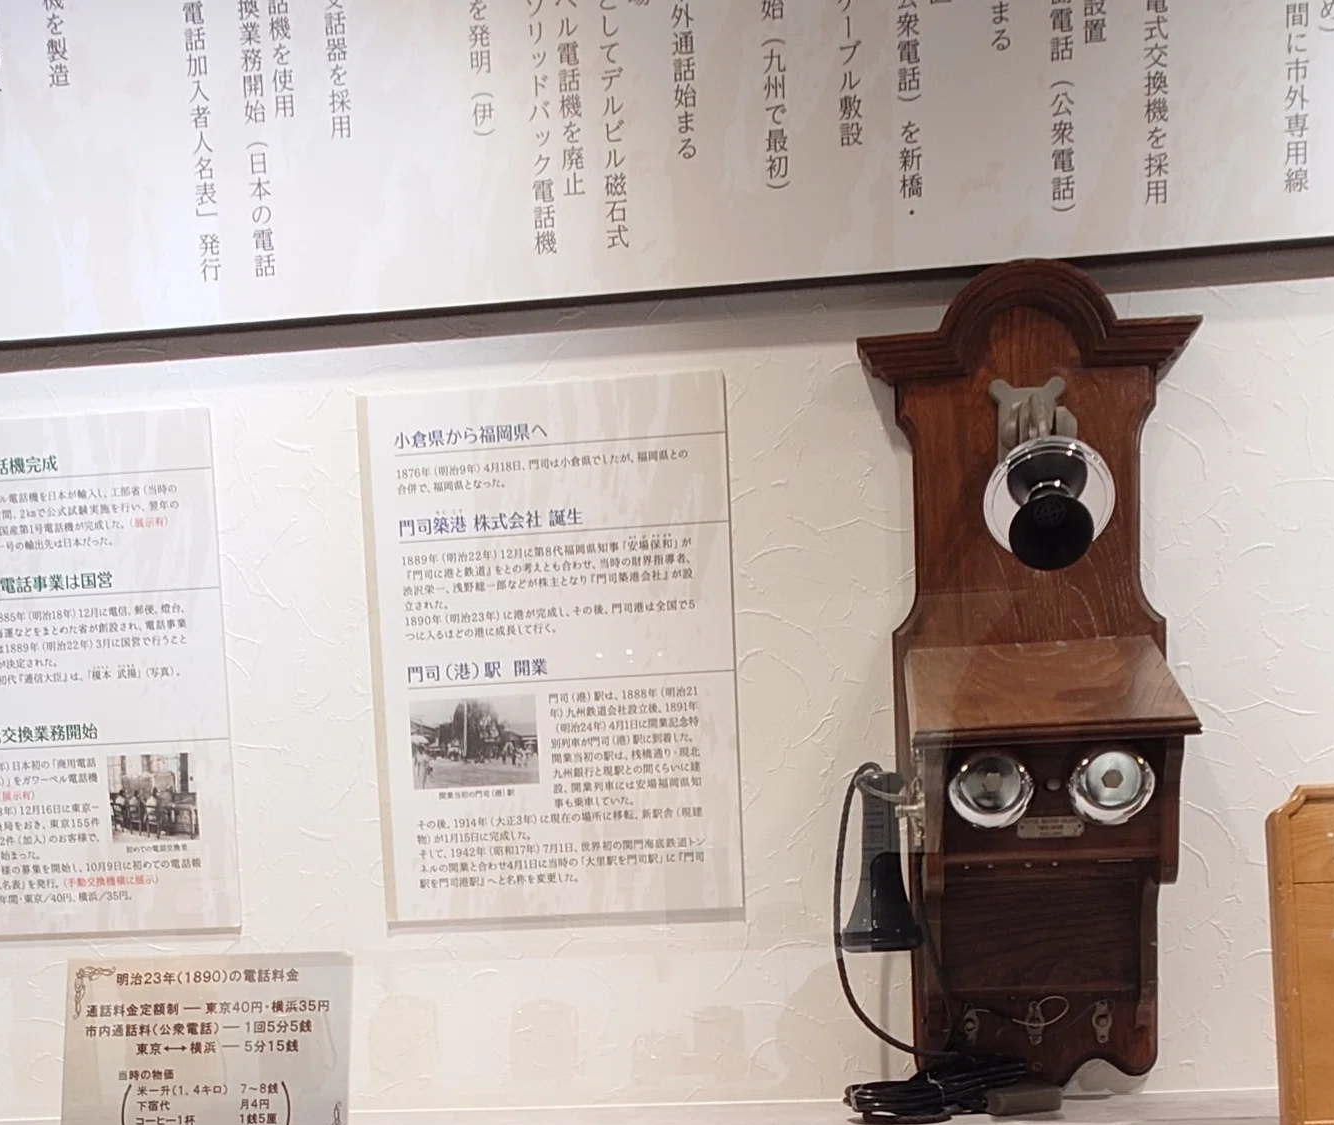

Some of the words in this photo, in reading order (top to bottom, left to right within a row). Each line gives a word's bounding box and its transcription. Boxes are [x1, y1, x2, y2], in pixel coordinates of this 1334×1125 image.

[990, 1, 1012, 52] まる
[1083, 0, 1107, 44] 設置
[670, 0, 697, 160] 外通話始まる
[1049, 0, 1076, 214] 電話（公衆電話）
[1284, 2, 1310, 194] 間に市外専用線
[393, 421, 548, 449] 小倉県から福岡県へ
[398, 514, 467, 537] 門司築港
[473, 510, 542, 532] 株式会社
[549, 508, 583, 527] 誕生
[407, 660, 502, 684] 門司（港）駅
[513, 658, 548, 677] 開業
[116, 968, 300, 986] 明治23年(1890)の電話料金
[136, 1042, 162, 1056] 東京
[117, 1069, 175, 1081] 当時の物価
[135, 1114, 196, 1125] コーヒー1杯
[240, 1113, 278, 1125] 1銭5厘
[136, 1100, 170, 1112] 下宿代
[239, 1098, 270, 1110] 月4円
